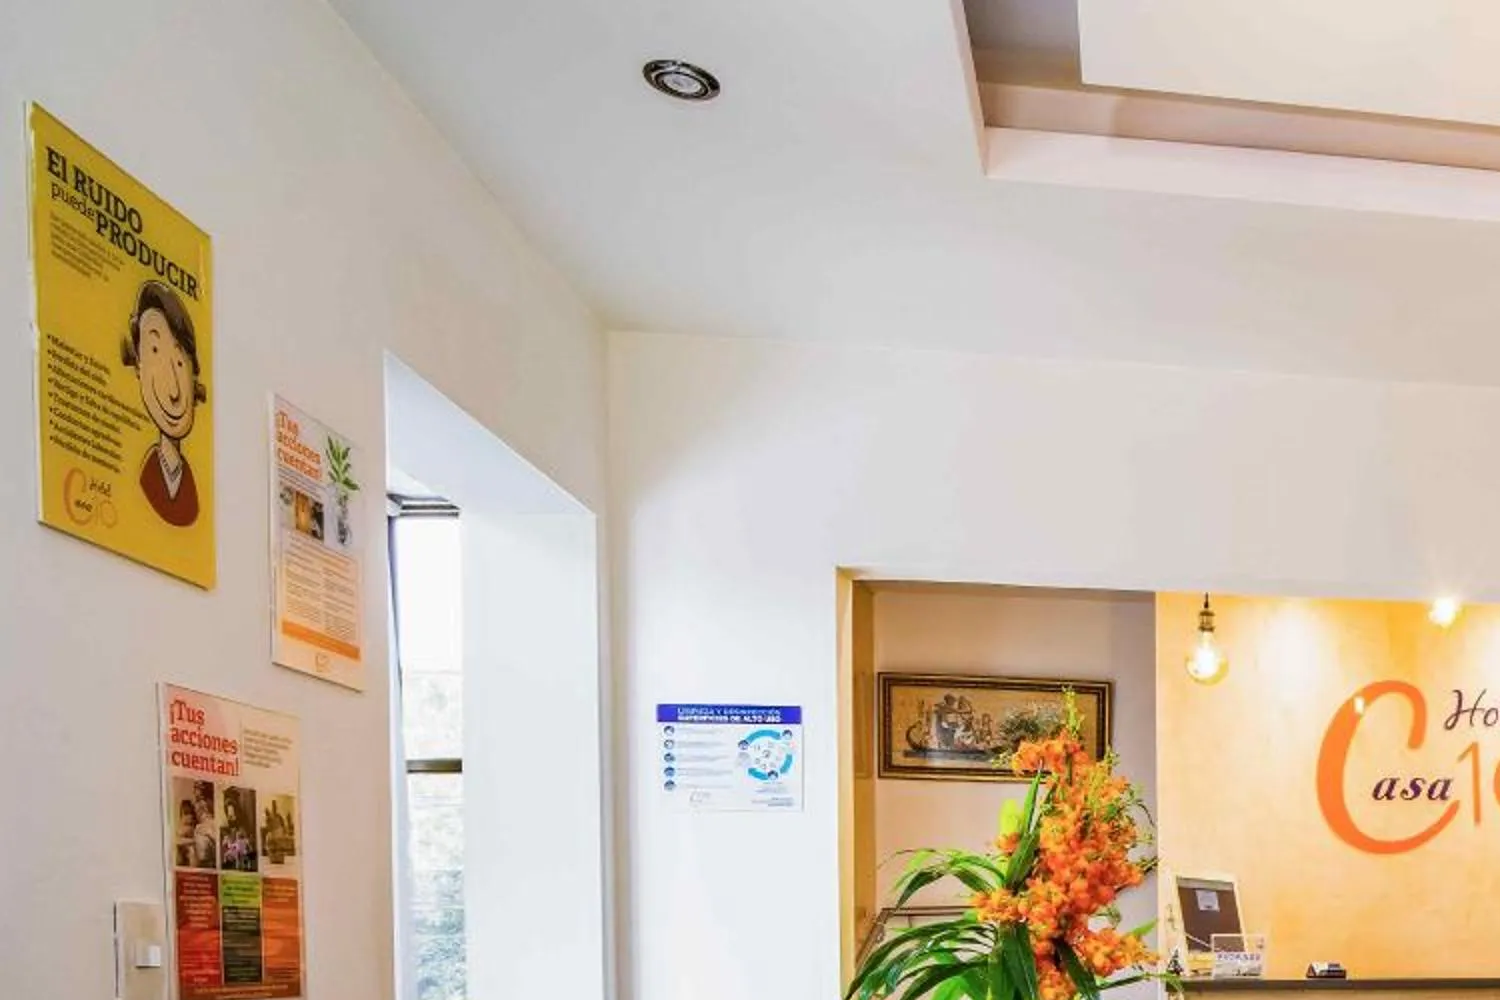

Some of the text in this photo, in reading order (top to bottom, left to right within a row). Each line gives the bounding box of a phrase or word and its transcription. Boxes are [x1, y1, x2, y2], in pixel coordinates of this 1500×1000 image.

[46, 145, 143, 235] El RUIDO
[51, 182, 95, 222] puede
[95, 209, 200, 301] PRODUCIR
[169, 699, 205, 726] ¡Tus
[170, 725, 238, 755] acciones
[171, 750, 239, 777] cuentan!
[1316, 679, 1460, 856] Casa
